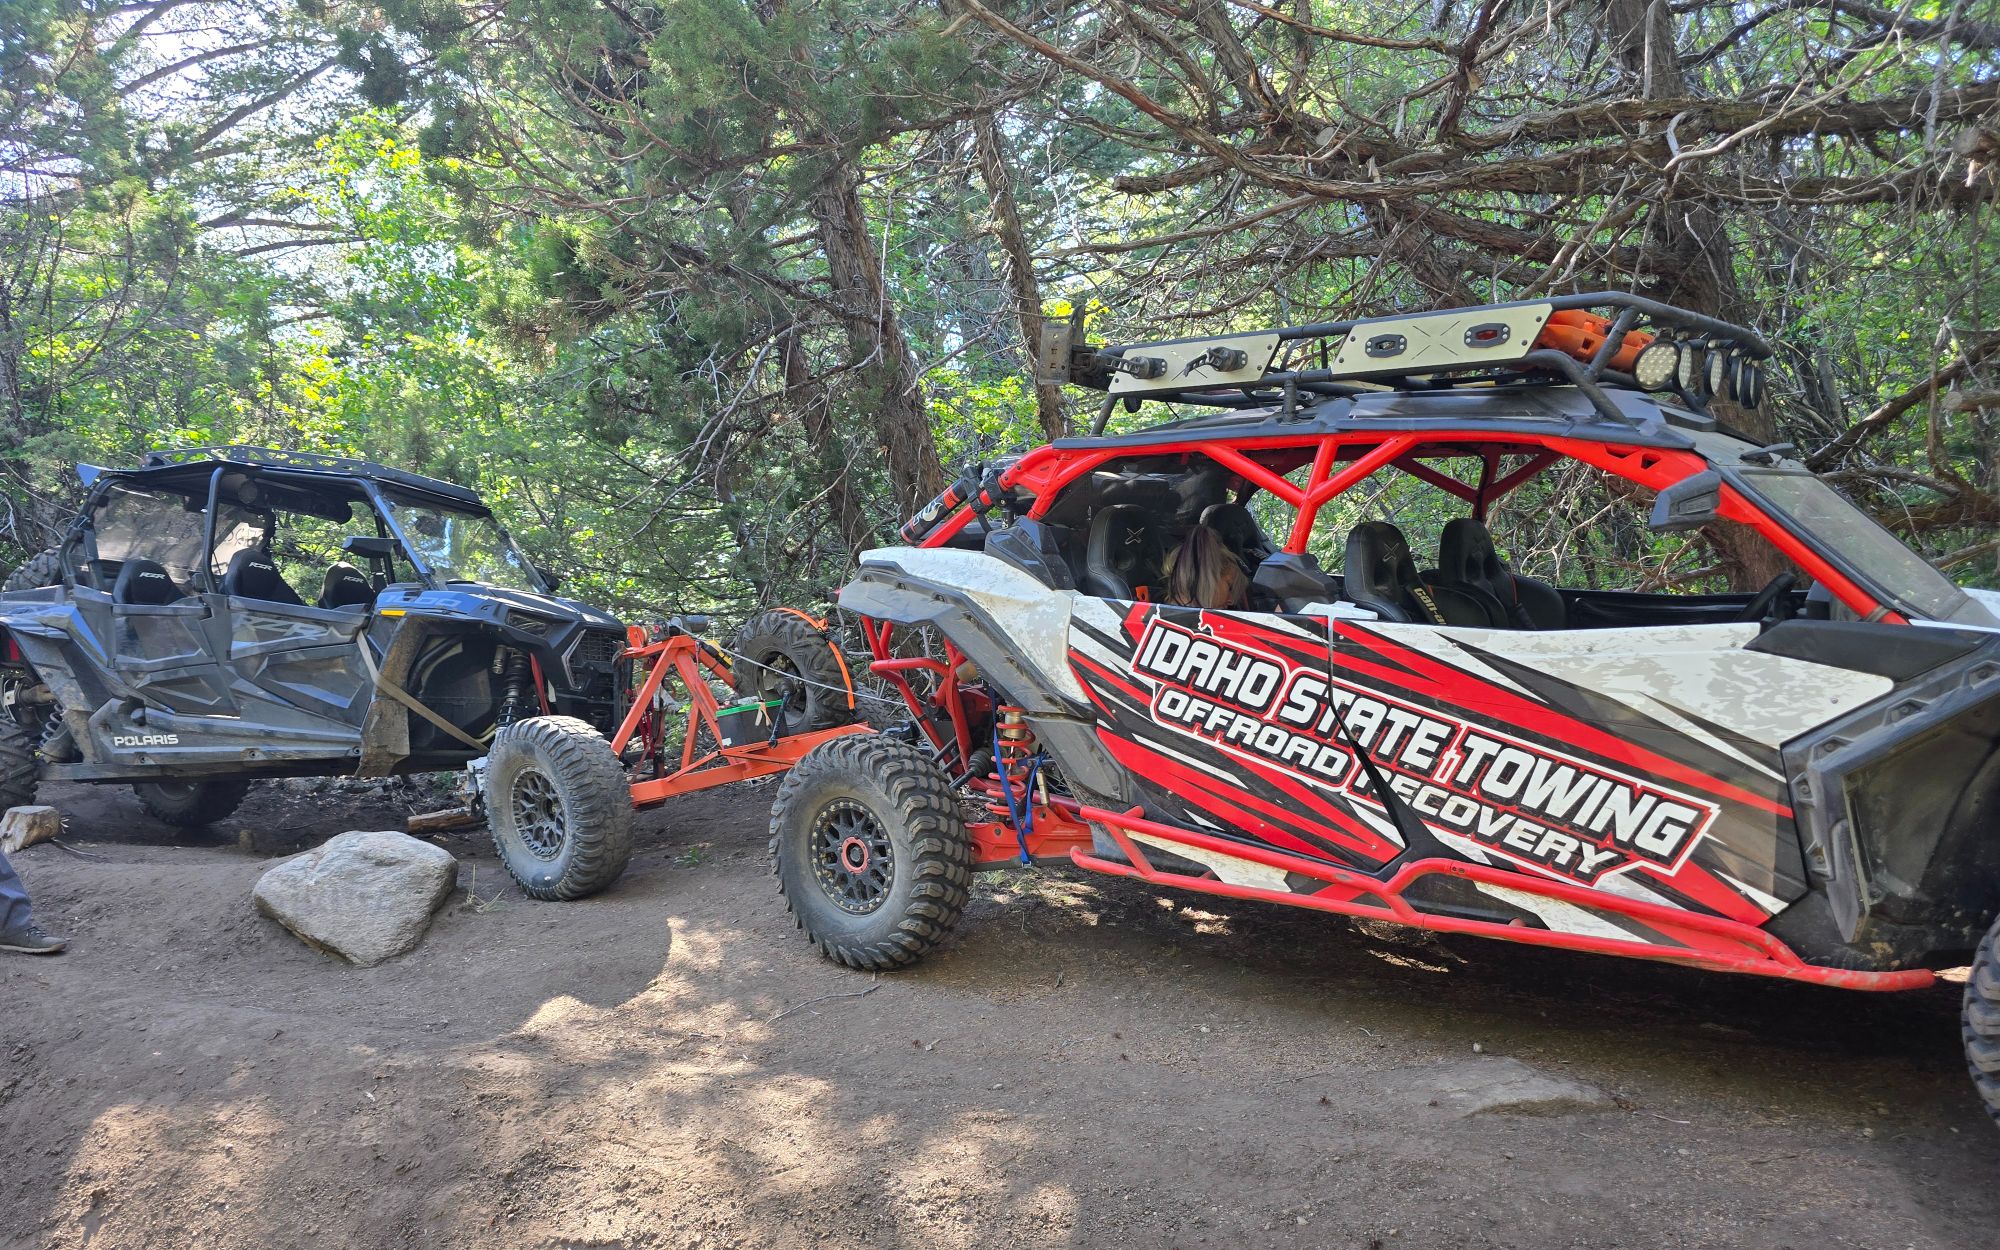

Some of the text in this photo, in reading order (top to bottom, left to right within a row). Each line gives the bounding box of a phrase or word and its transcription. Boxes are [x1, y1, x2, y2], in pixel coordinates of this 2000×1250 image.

[249, 561, 273, 571] RZR
[113, 734, 179, 747] POLARIS
[1138, 625, 1700, 858] IDAHO STATE TOWING
[1157, 688, 1350, 777] OFFROAD
